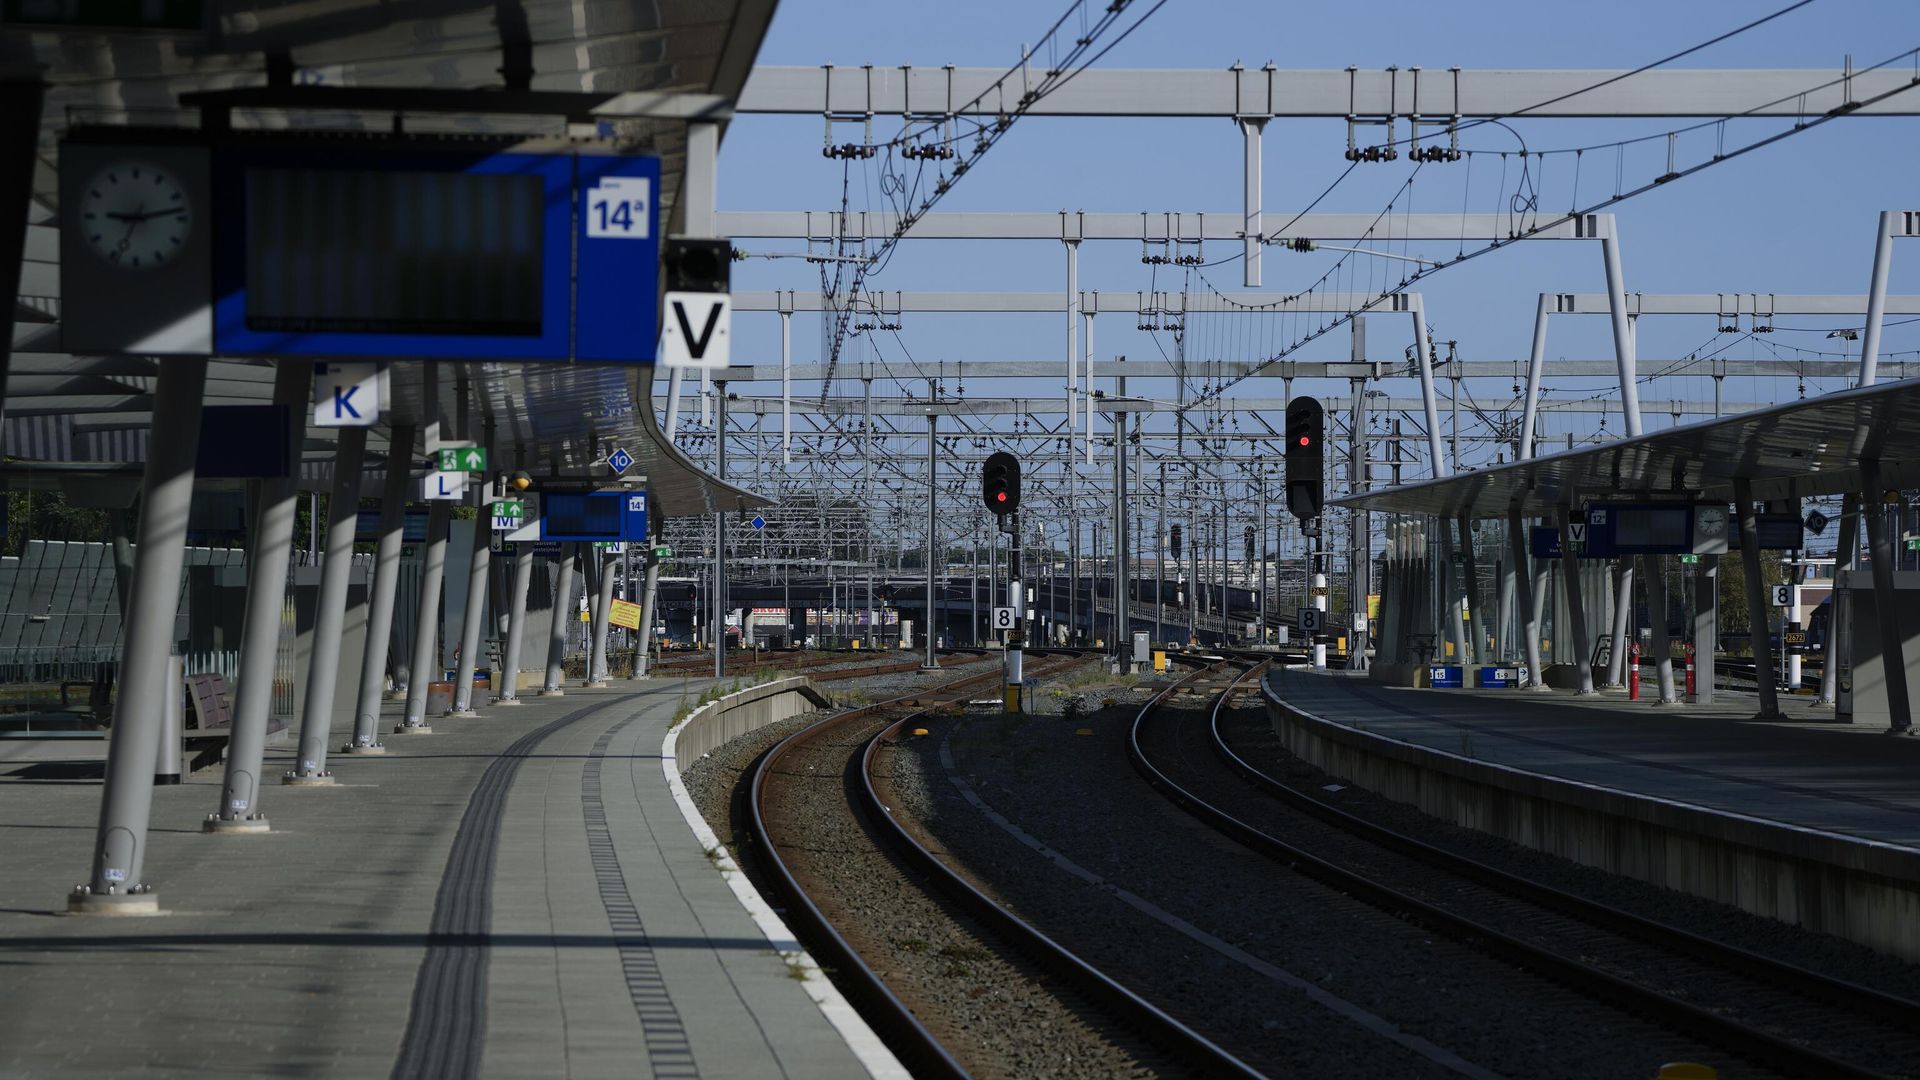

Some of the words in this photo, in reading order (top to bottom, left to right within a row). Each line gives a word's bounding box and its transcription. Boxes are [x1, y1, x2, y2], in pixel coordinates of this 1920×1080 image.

[594, 199, 645, 231] 14a
[672, 302, 724, 359] V
[335, 386, 361, 418] K
[614, 455, 628, 467] 10
[439, 476, 450, 495] L
[1811, 516, 1824, 528] 10
[1571, 525, 1584, 540] V
[611, 541, 620, 551] N
[1312, 587, 1328, 596] 2670
[1778, 588, 1788, 604] 8
[999, 610, 1010, 626] 8
[1304, 611, 1315, 628] 8
